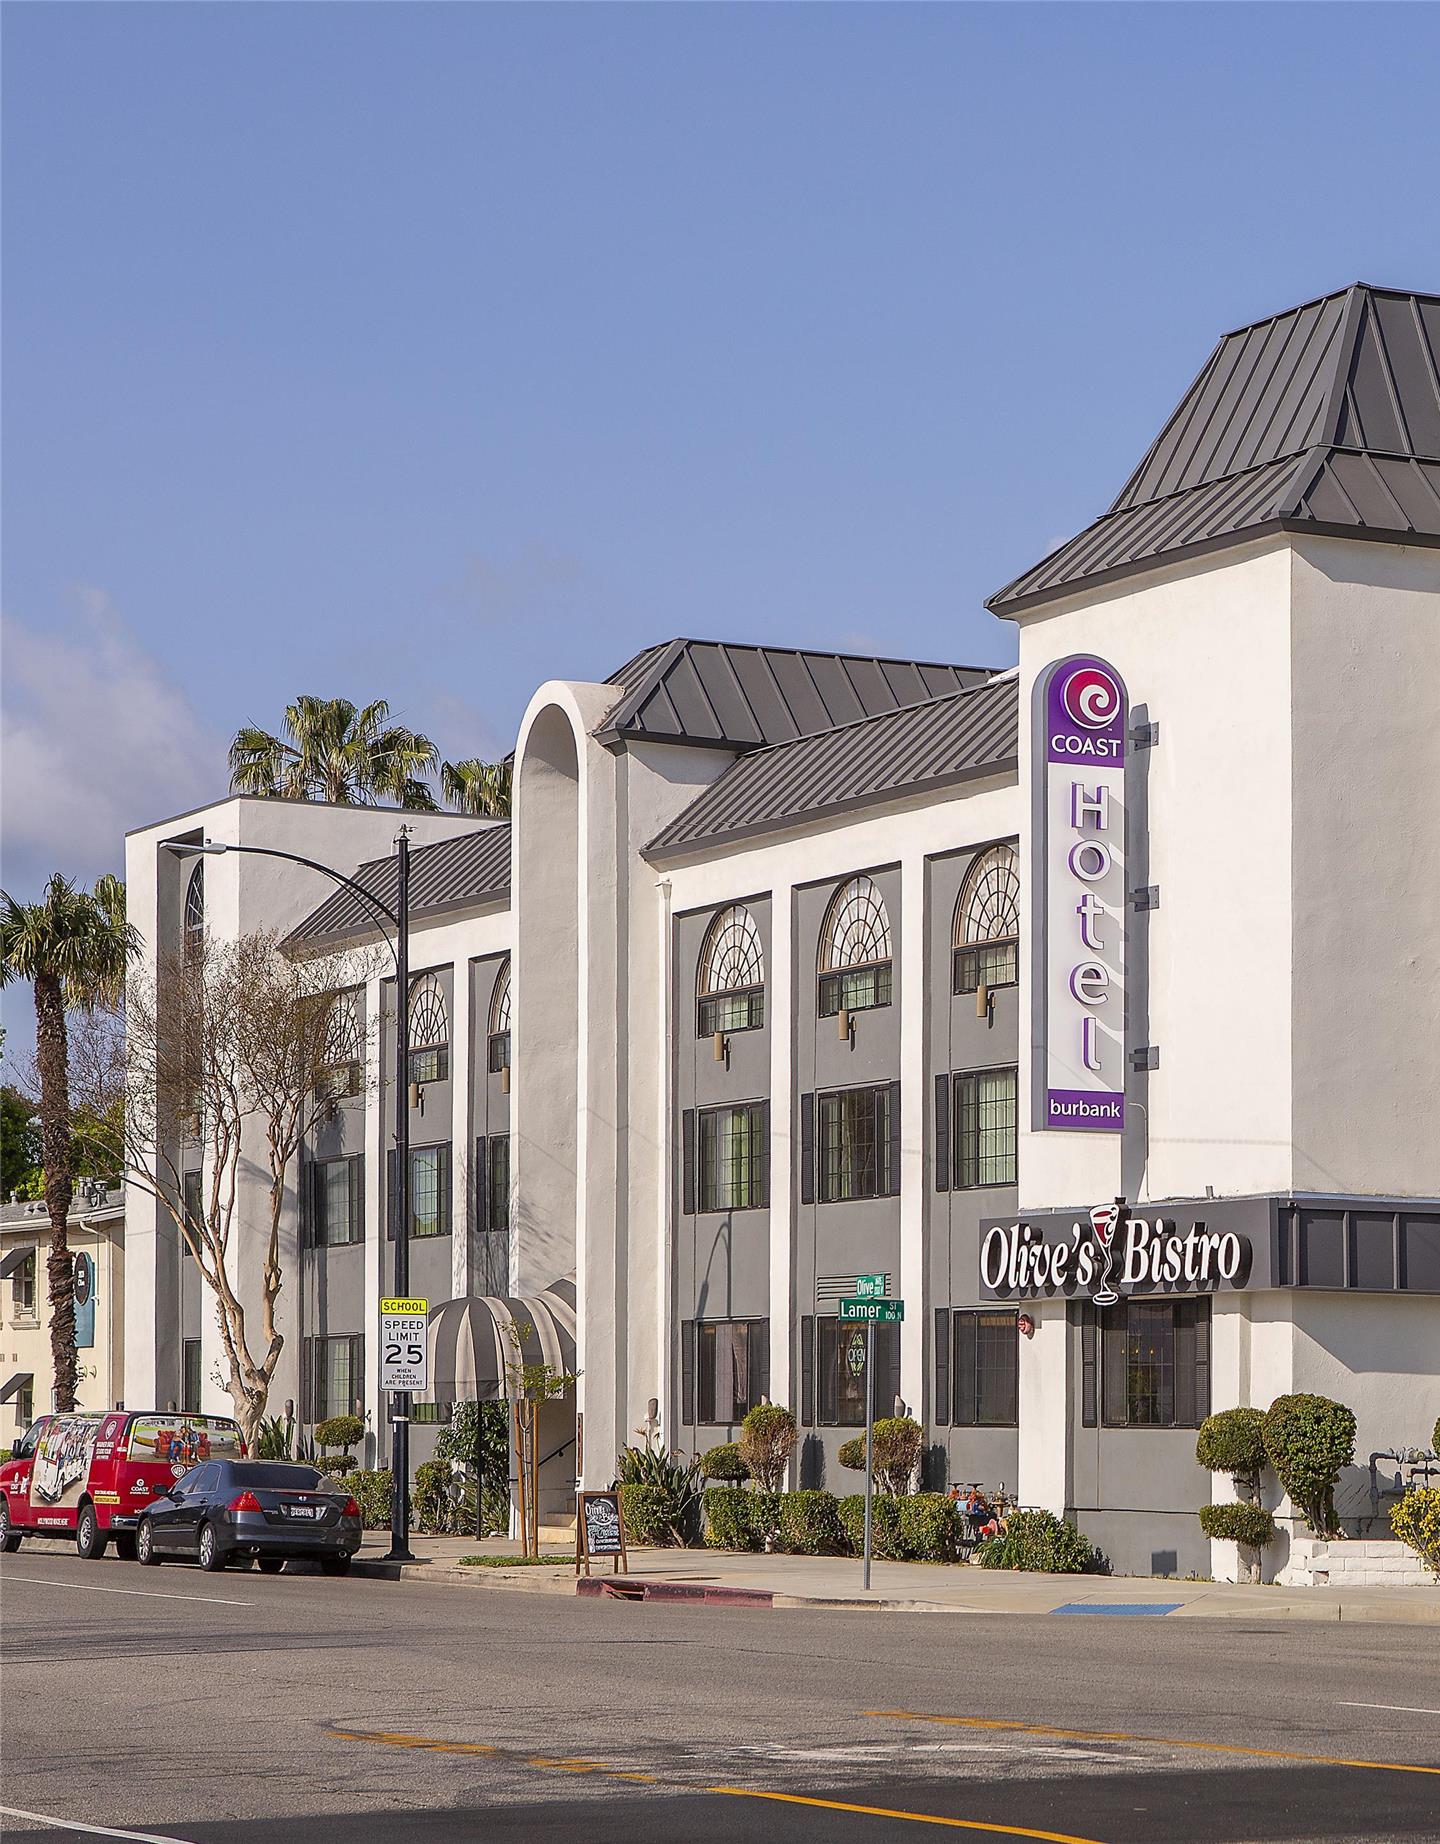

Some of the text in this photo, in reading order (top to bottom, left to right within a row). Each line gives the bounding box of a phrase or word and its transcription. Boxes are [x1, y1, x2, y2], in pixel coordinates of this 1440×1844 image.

[1051, 734, 1122, 757] COAST
[1068, 781, 1111, 1070] Hotel
[1050, 1098, 1121, 1118] burbank
[980, 1218, 1241, 1289] Olive's Bistro
[857, 1279, 874, 1296] Olive
[383, 1302, 425, 1312] SCHOOL
[841, 1301, 882, 1318] Lamer
[384, 1320, 424, 1330] SPEED
[388, 1332, 420, 1341] LIMIT
[385, 1344, 424, 1365] 25
[848, 1348, 866, 1362] OPEN
